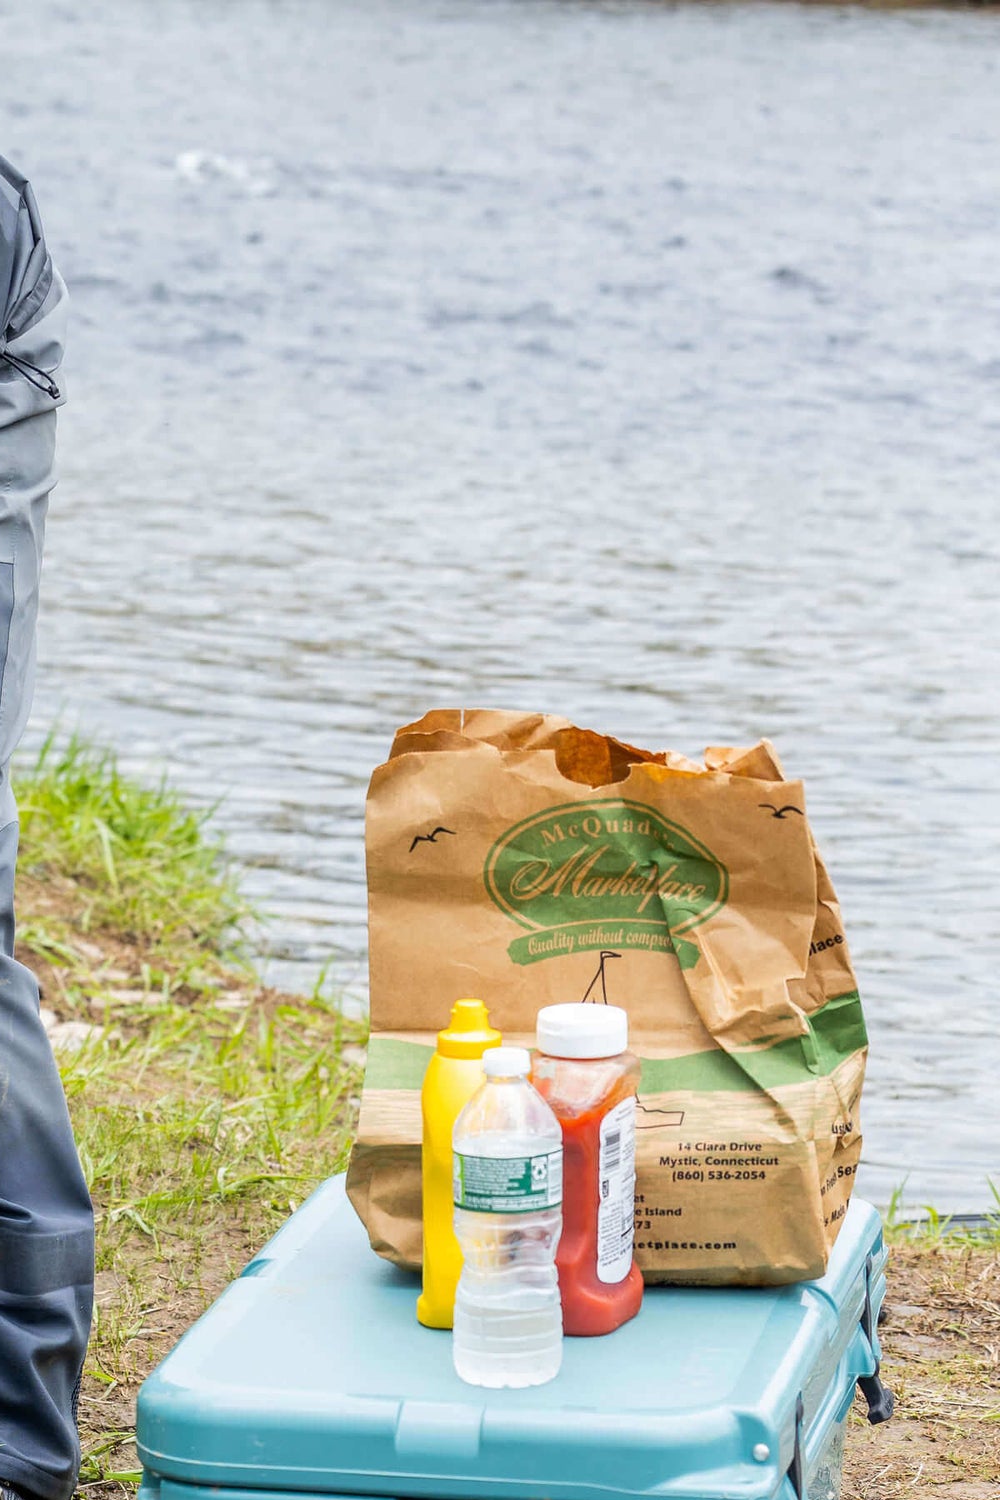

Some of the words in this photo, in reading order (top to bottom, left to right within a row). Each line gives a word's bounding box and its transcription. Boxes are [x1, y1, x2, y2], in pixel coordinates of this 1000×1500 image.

[528, 930, 574, 956] Quality
[578, 928, 624, 947] without
[678, 1143, 691, 1151] 14
[695, 1143, 726, 1151] Clara
[730, 1143, 762, 1151] Drive
[659, 1156, 701, 1168] Mystic,
[705, 1156, 779, 1166] Connecticut
[672, 1171, 704, 1182] (860)
[708, 1171, 766, 1180] 536-2054
[645, 1207, 682, 1216] Island
